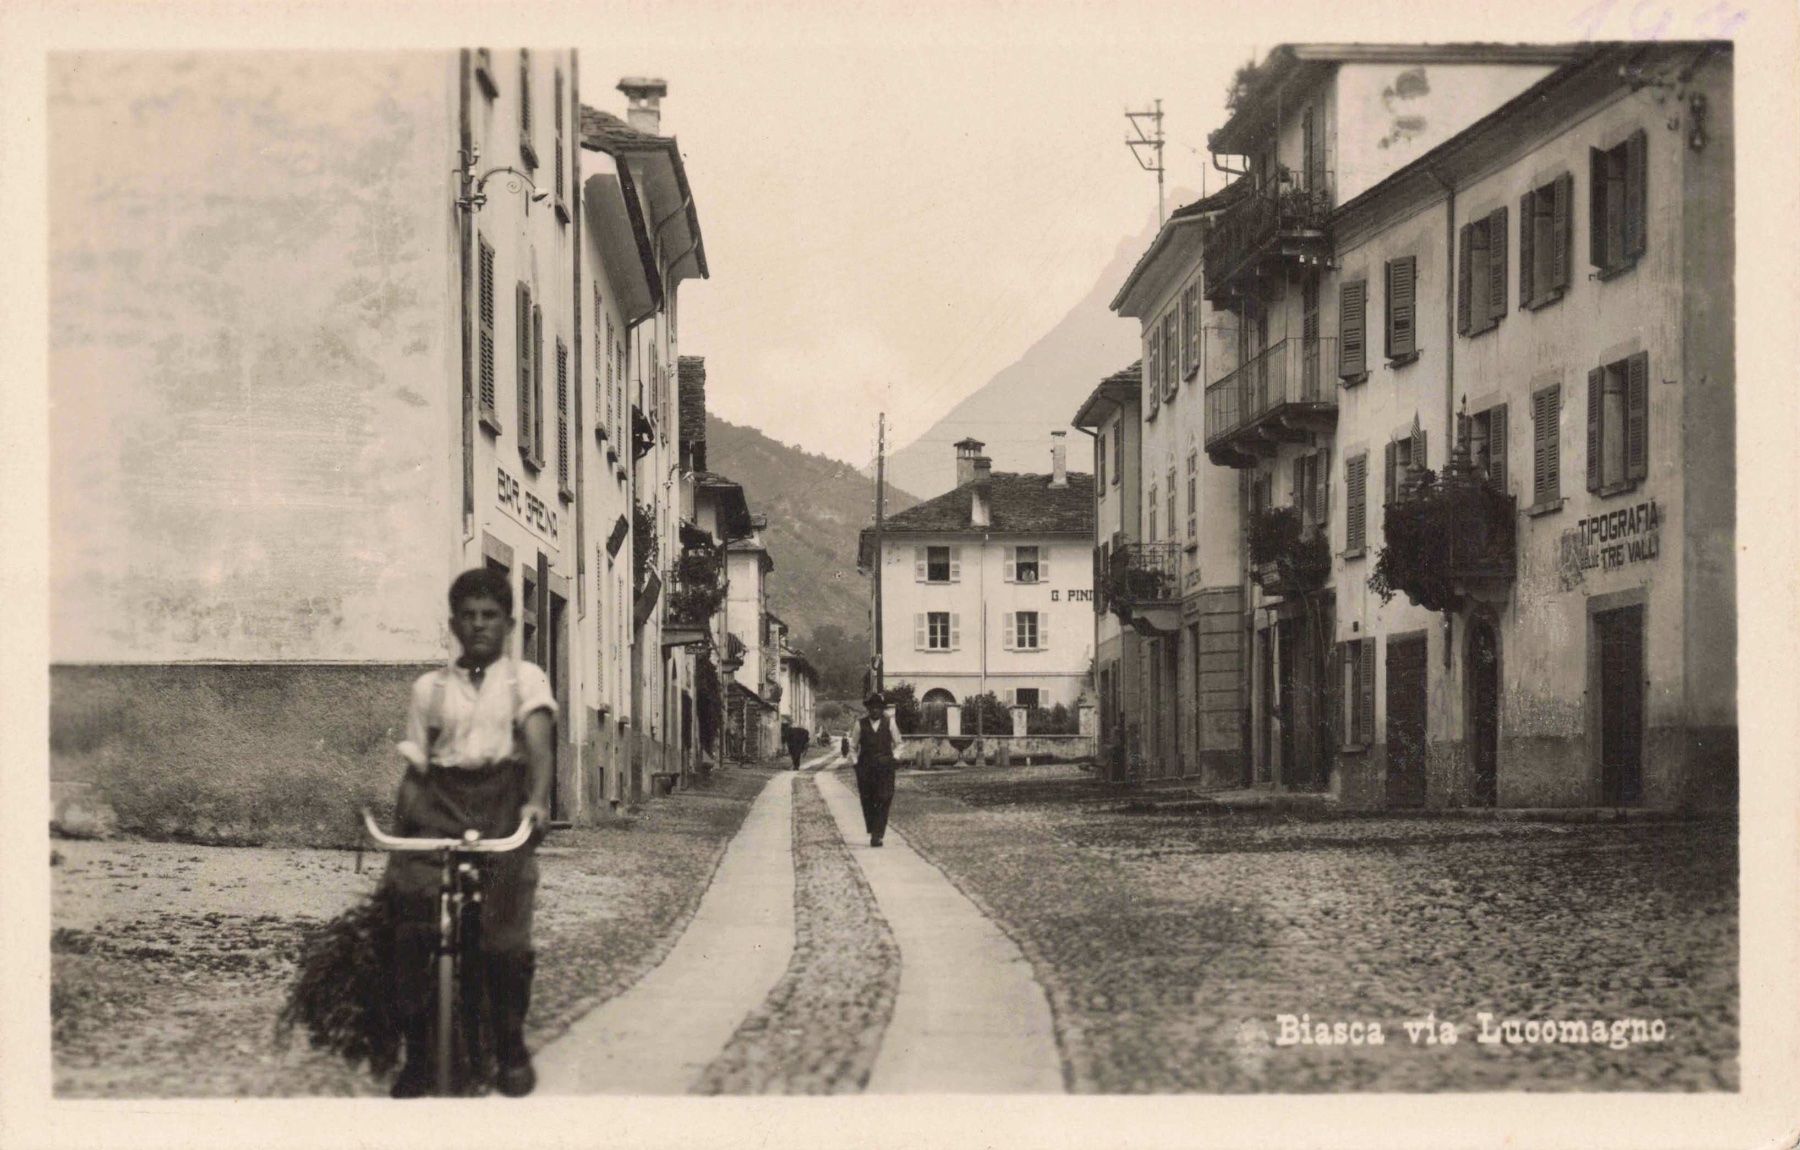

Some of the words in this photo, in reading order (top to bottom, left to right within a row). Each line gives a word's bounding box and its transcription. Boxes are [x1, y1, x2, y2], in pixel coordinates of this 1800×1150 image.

[498, 467, 521, 515] BAR
[1578, 500, 1659, 546] TIPOGRAFIA
[1601, 545, 1625, 570] TRE
